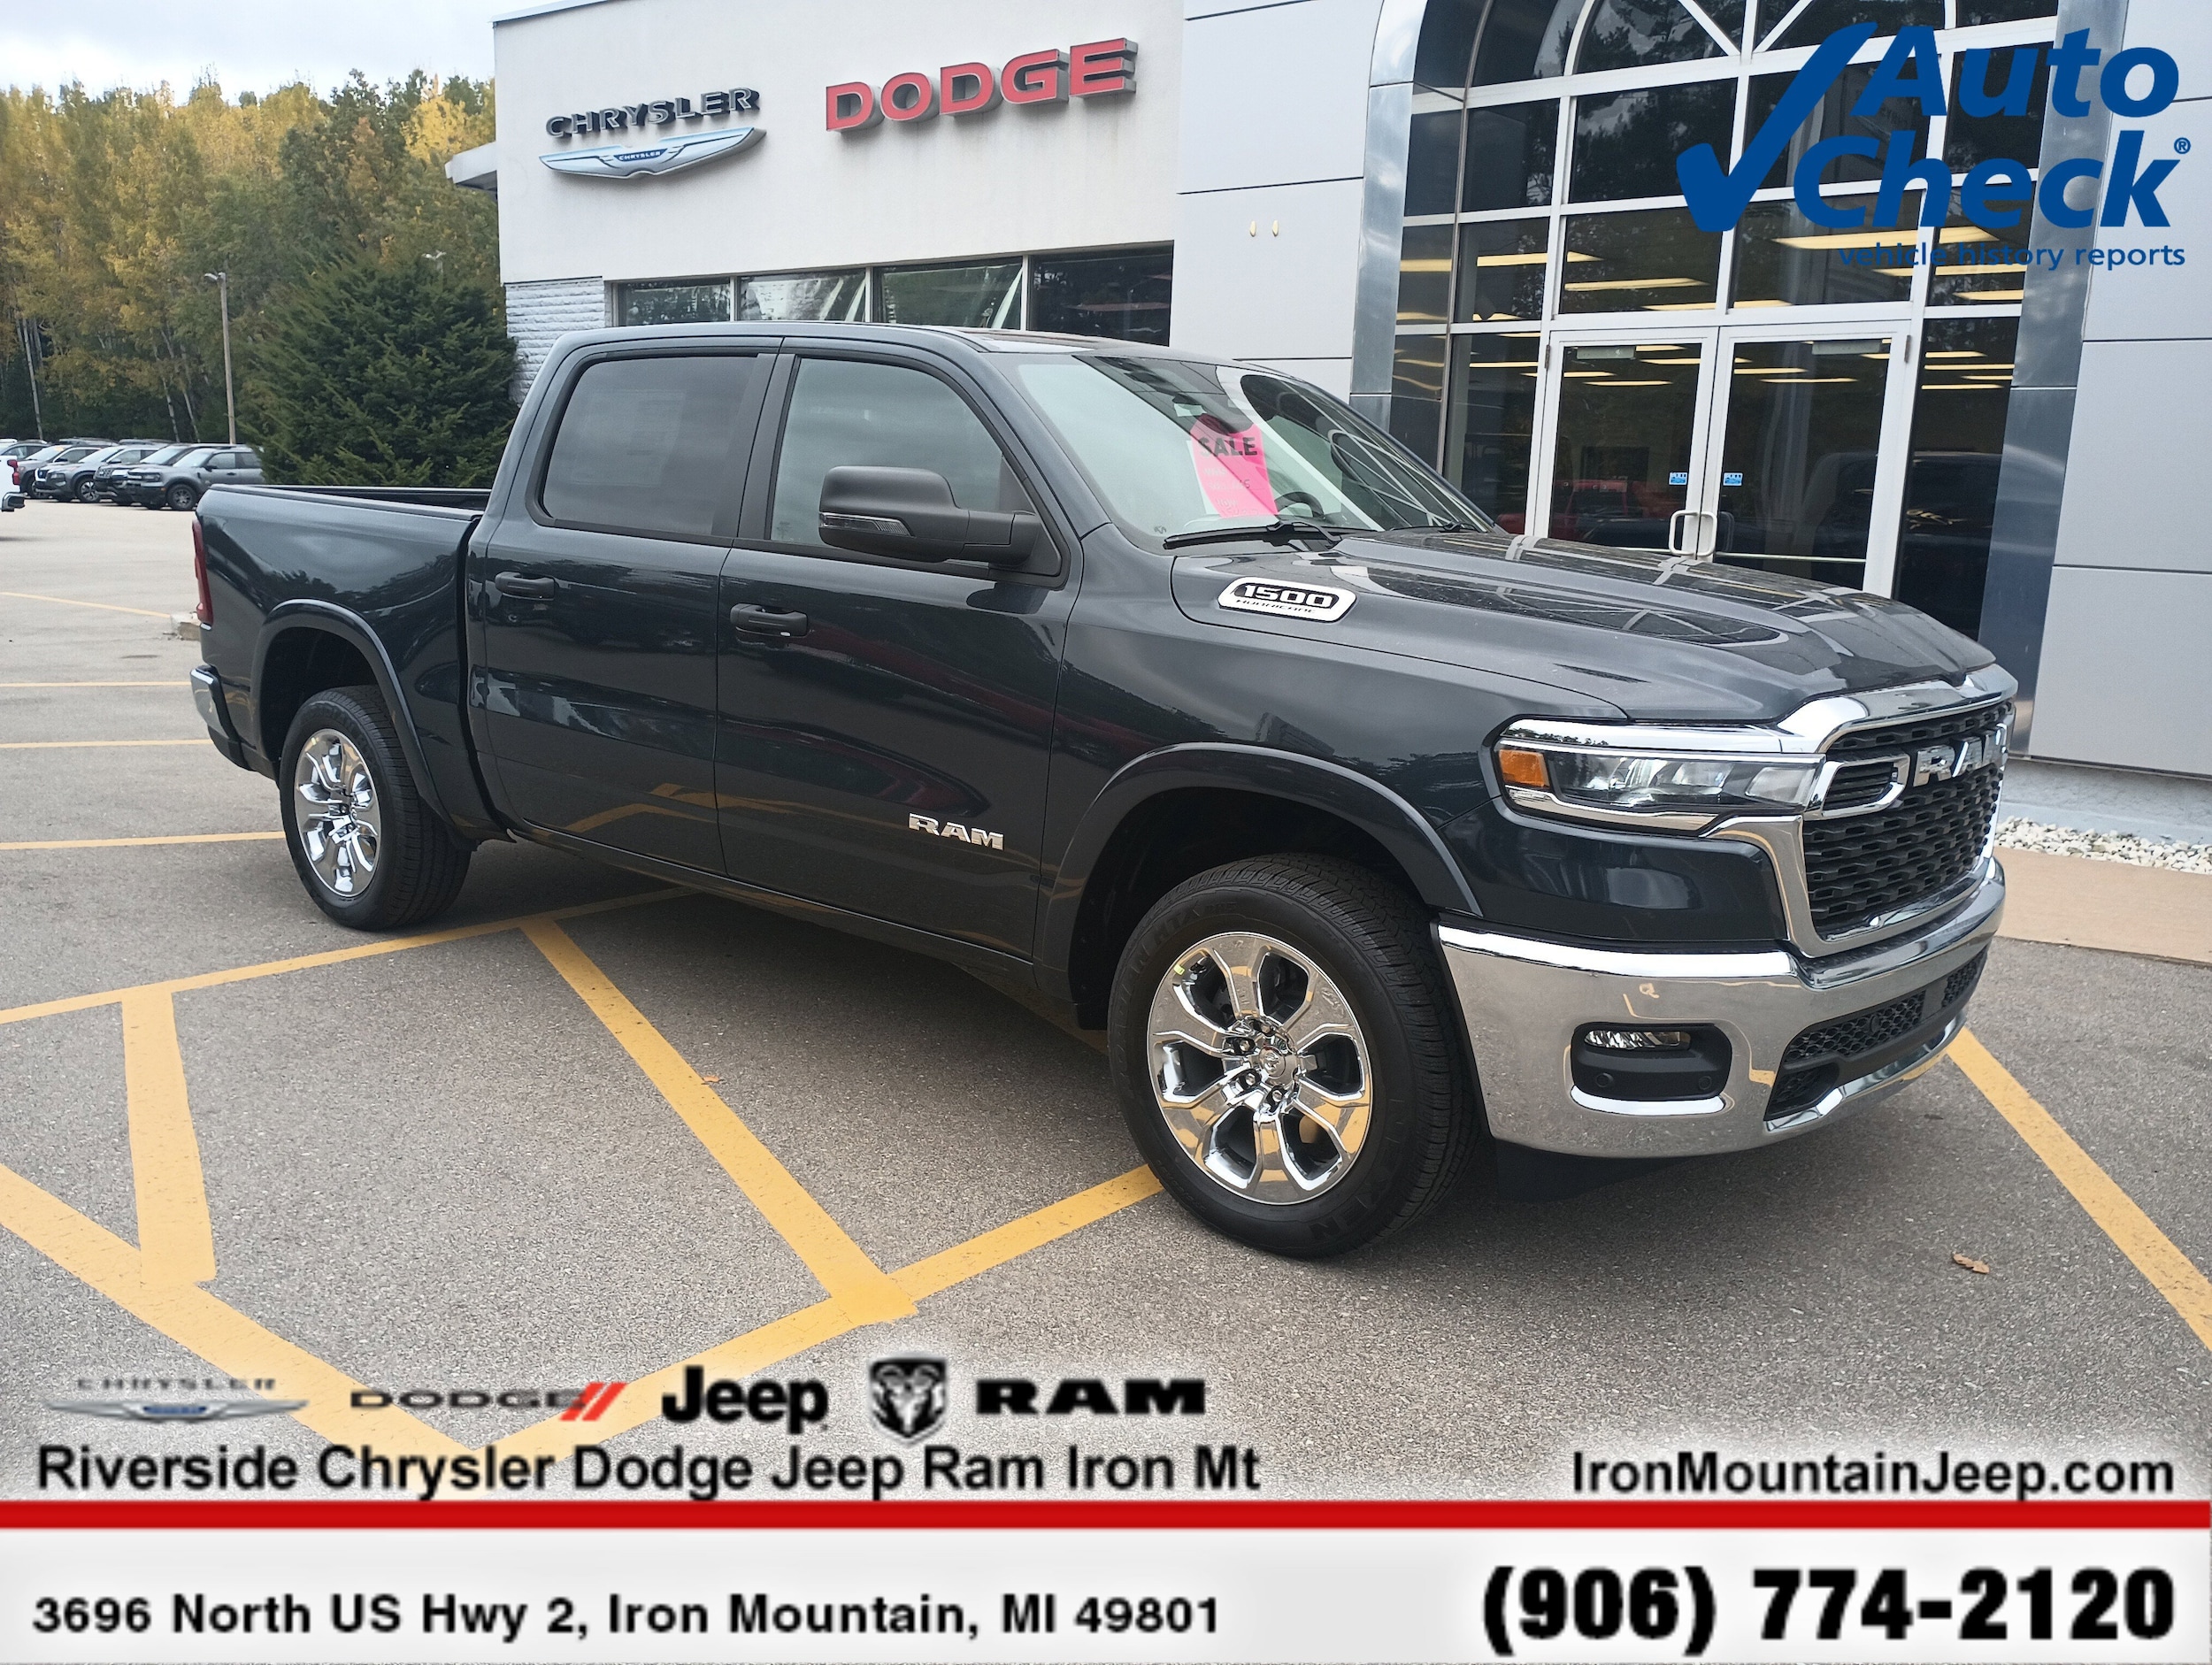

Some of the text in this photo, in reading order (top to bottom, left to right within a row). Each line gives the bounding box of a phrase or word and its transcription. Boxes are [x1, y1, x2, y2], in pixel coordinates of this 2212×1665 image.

[826, 37, 1137, 132] DODGE
[545, 87, 759, 139] CHRYSLER
[618, 150, 662, 161] CHRYSLER
[1198, 437, 1257, 457] SALE
[1244, 584, 1333, 609] 1500
[909, 813, 1003, 850] RAM
